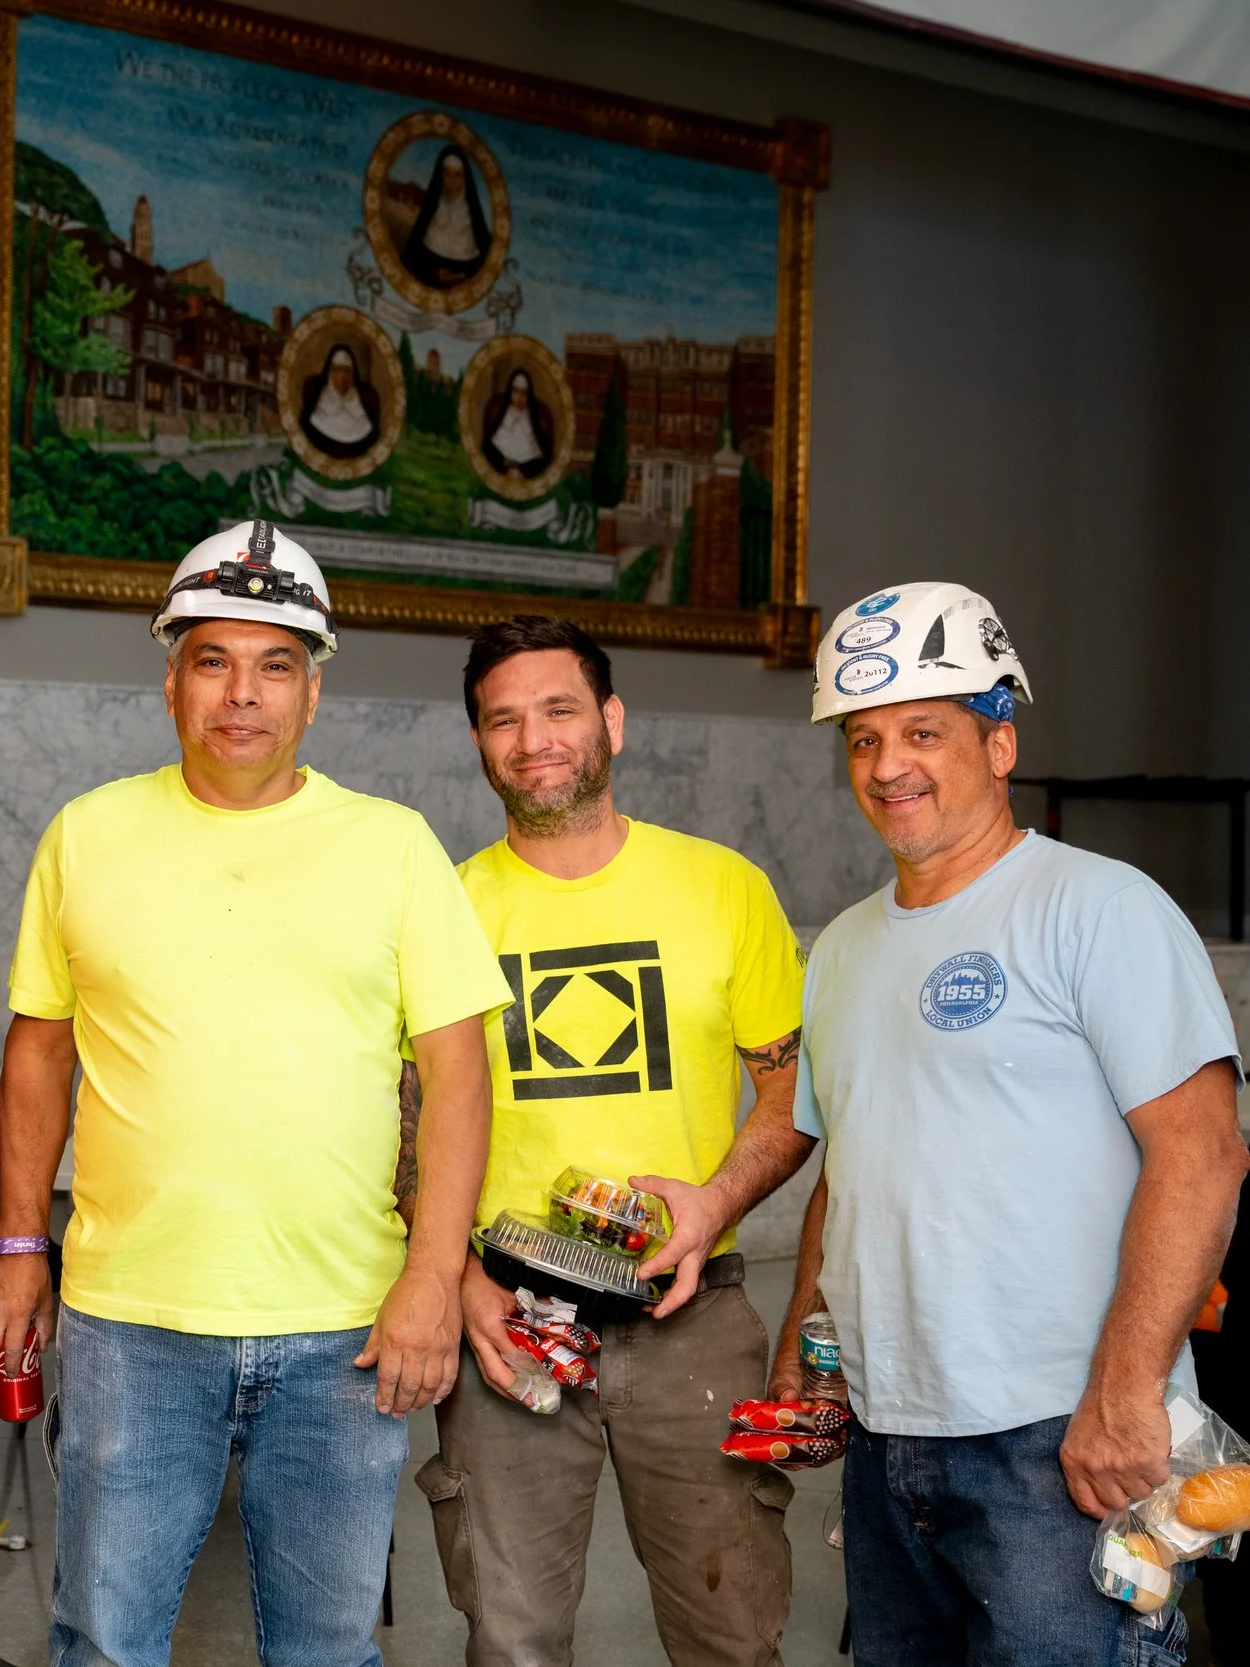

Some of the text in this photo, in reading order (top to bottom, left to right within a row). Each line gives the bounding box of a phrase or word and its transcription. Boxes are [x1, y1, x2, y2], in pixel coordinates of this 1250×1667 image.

[856, 636, 872, 645] 489
[925, 955, 1002, 989] DRYWALL FINISHERS
[937, 983, 986, 1002] 1955
[925, 1006, 992, 1029] LOCAL UNION
